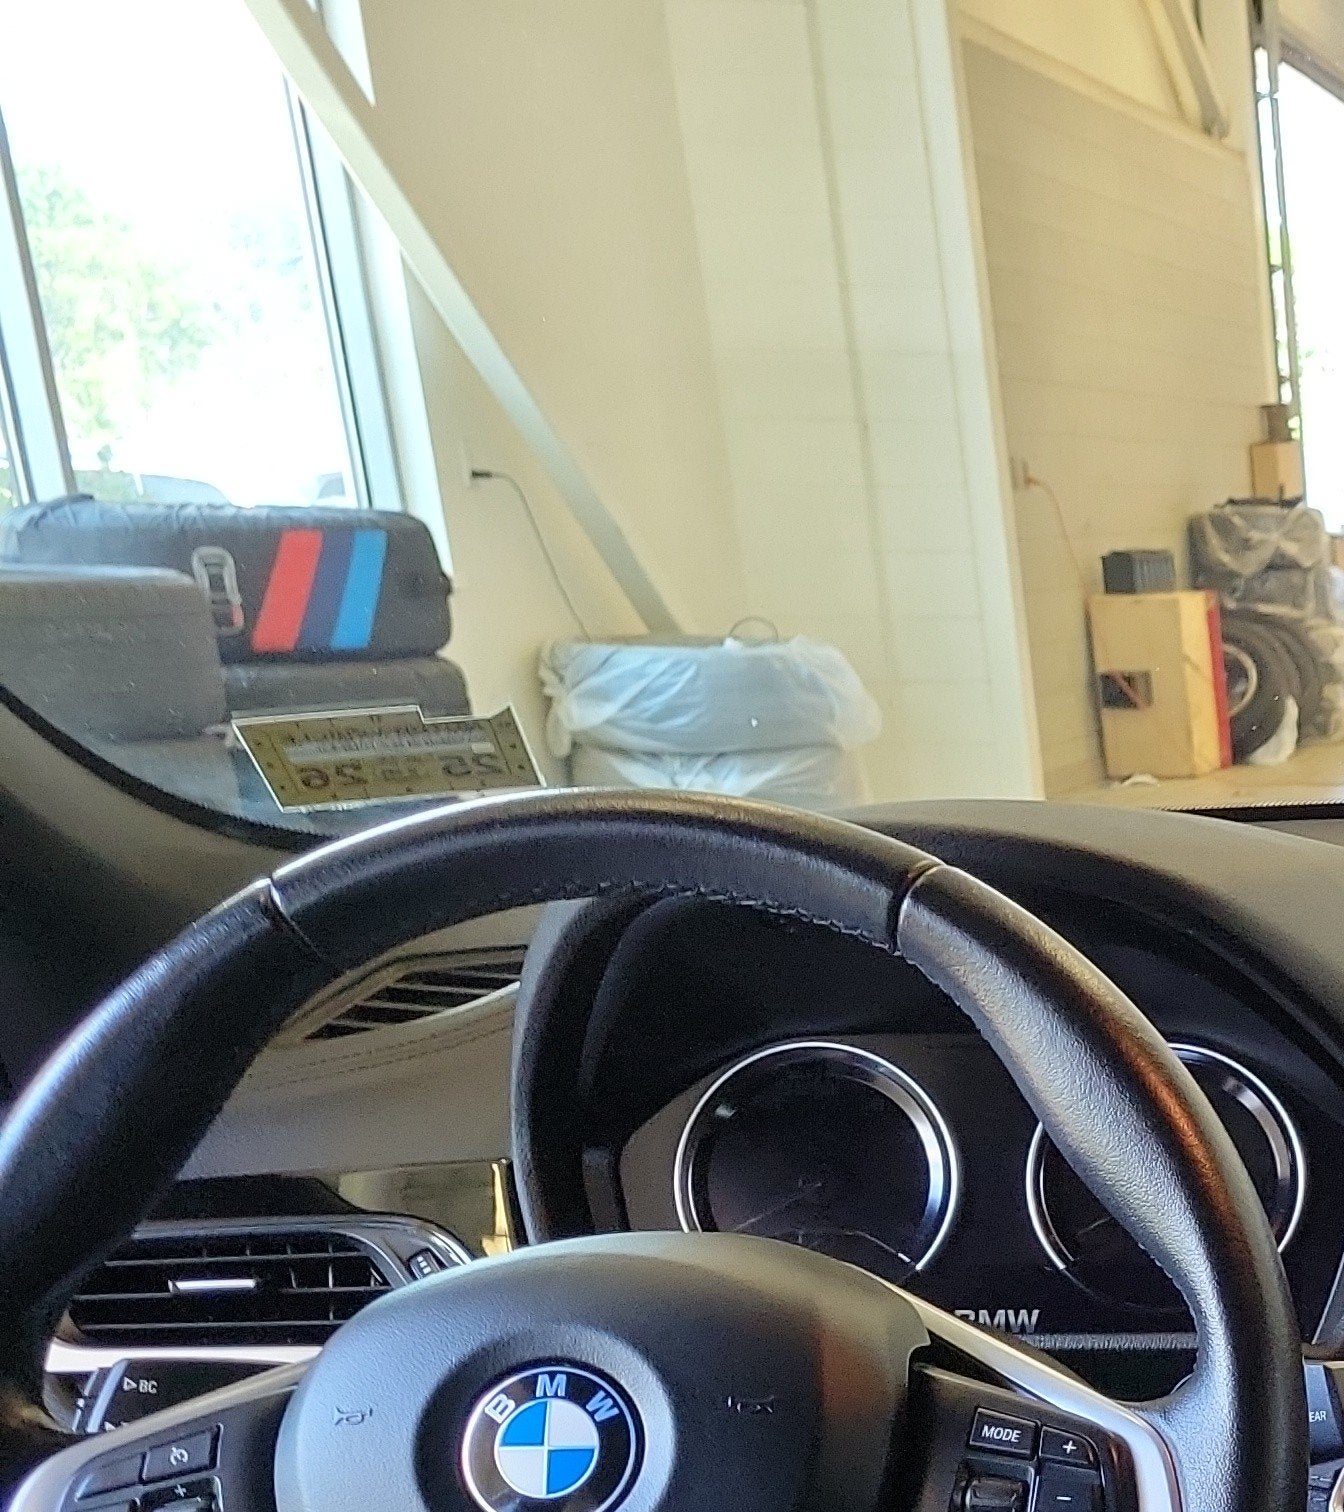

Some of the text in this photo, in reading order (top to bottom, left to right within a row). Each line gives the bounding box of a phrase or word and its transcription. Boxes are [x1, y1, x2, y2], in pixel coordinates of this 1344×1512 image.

[139, 1379, 158, 1395] BC
[484, 1373, 620, 1424] BMW
[1309, 1410, 1327, 1423] EAR
[981, 1425, 1022, 1443] MODE
